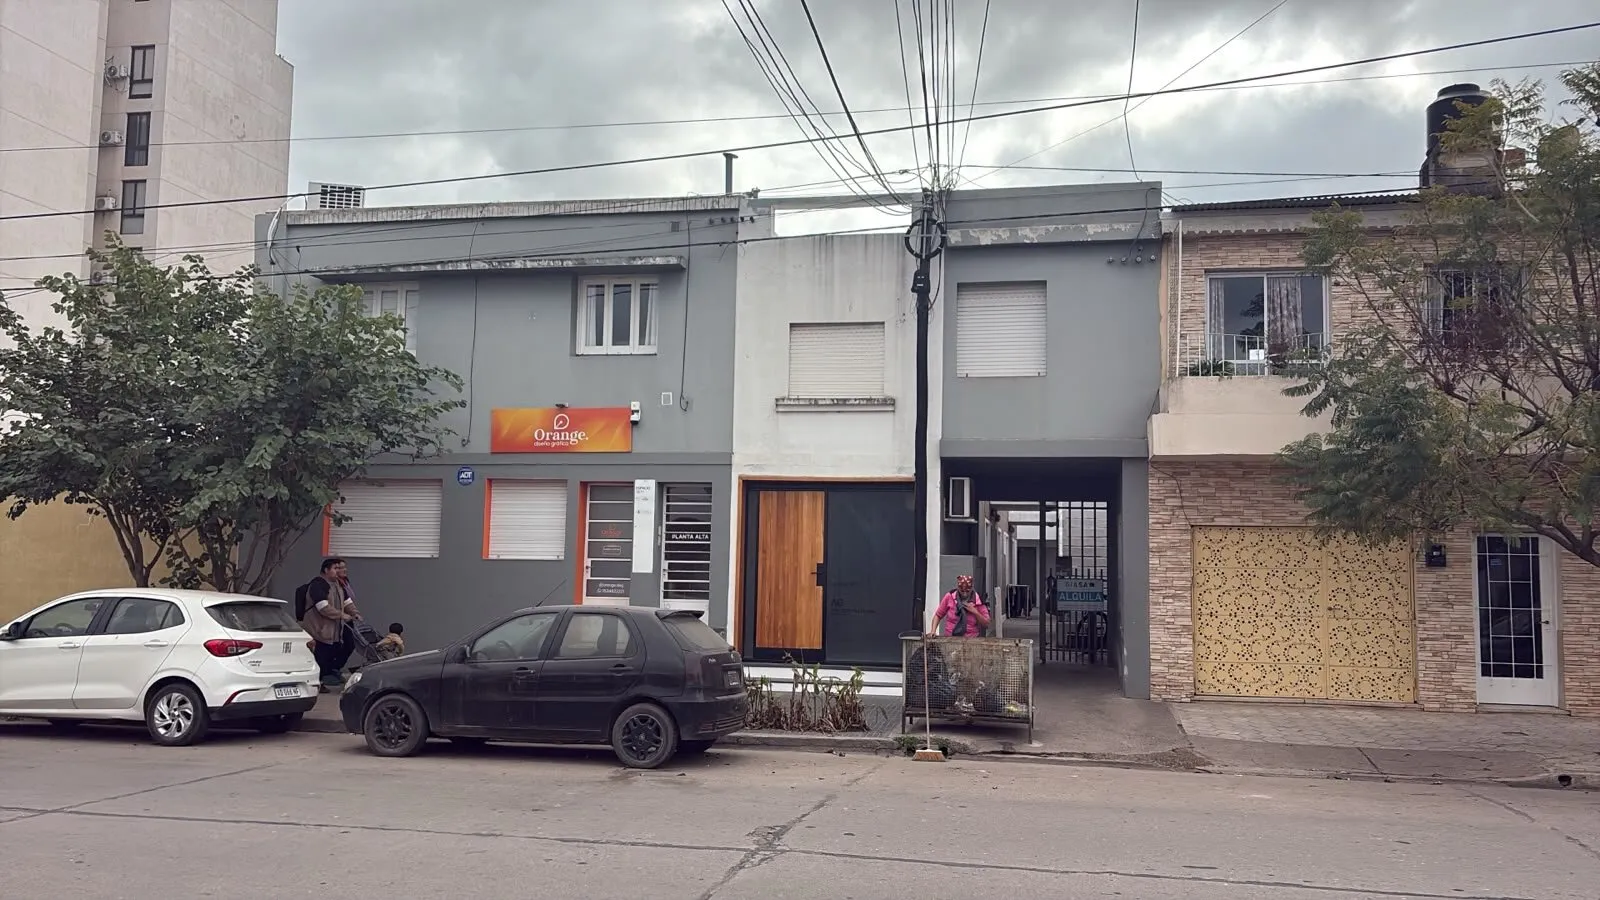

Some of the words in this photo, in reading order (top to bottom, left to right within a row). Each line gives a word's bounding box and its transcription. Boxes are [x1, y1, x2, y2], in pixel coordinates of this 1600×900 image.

[534, 428, 589, 446] Orange.
[459, 471, 473, 479] ADT
[1059, 592, 1102, 601] ALQUILA
